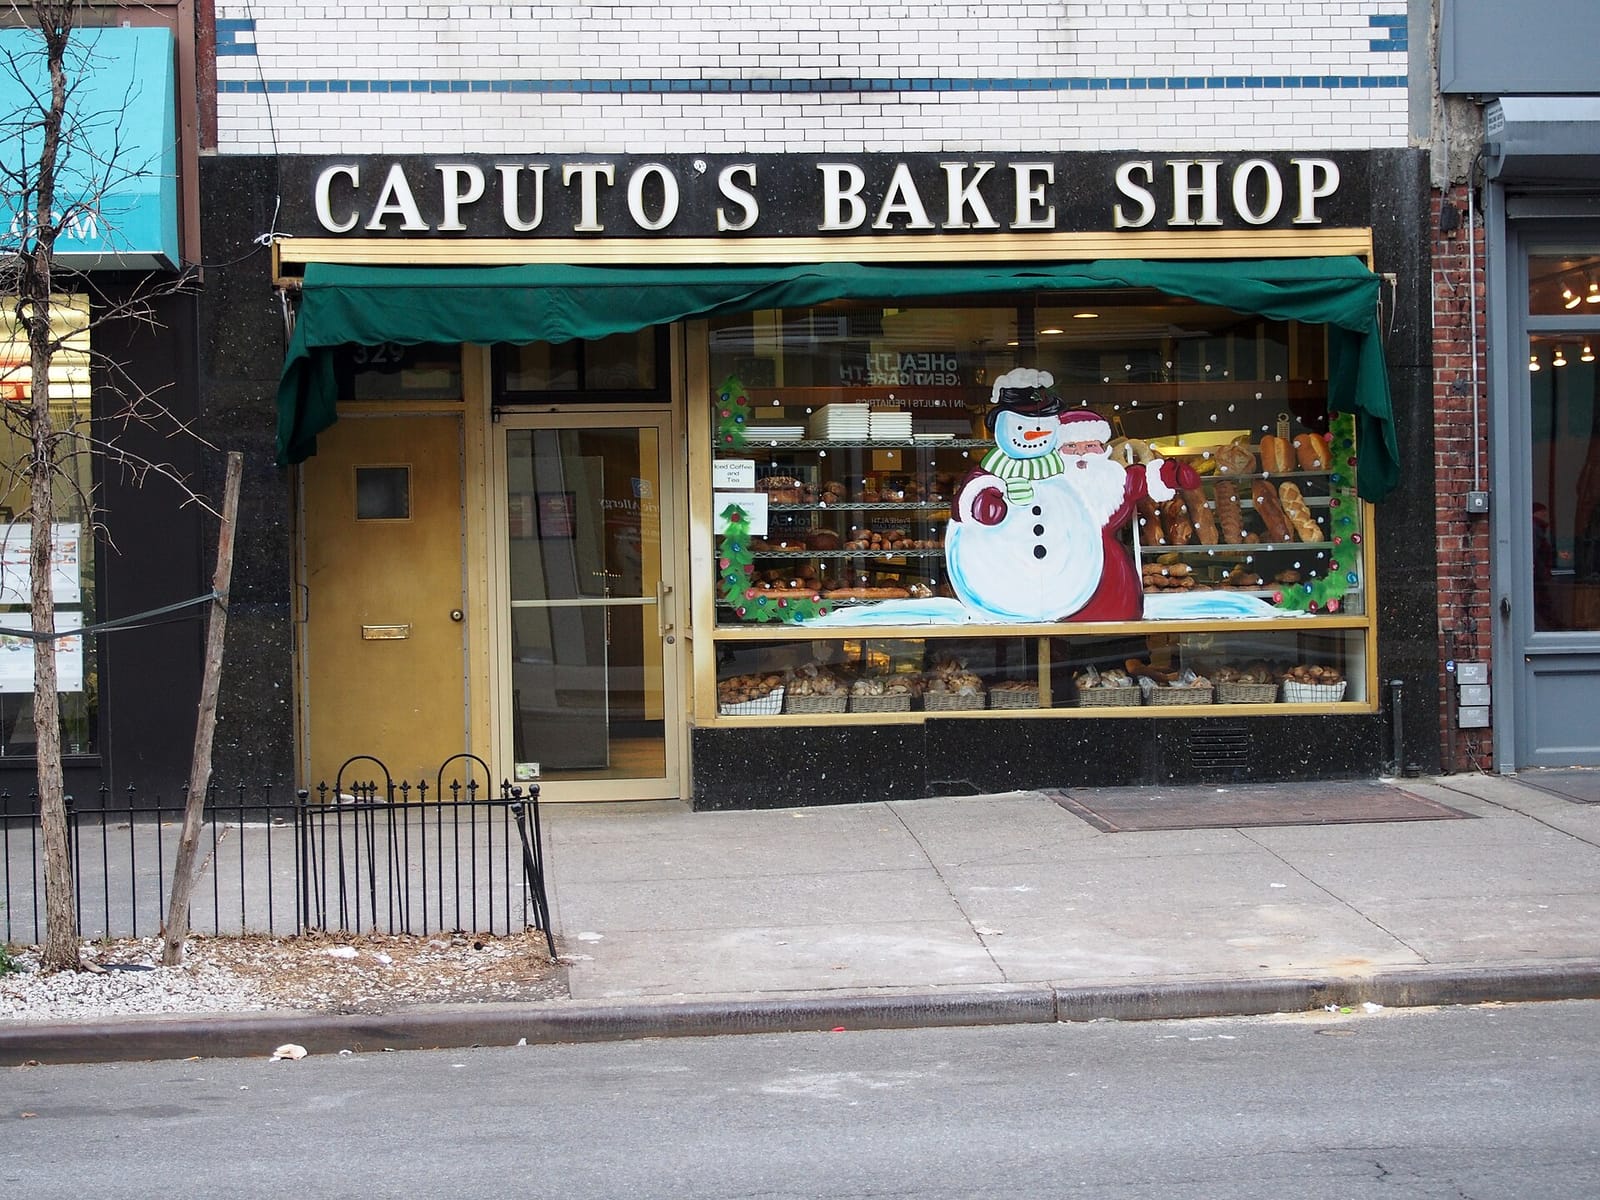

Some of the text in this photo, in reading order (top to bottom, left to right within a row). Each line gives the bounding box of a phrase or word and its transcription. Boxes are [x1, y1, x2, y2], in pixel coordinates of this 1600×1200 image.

[314, 158, 1341, 232] CAPUTO'S BAKE SHOP
[353, 344, 404, 364] 329
[729, 463, 753, 471] Coffee
